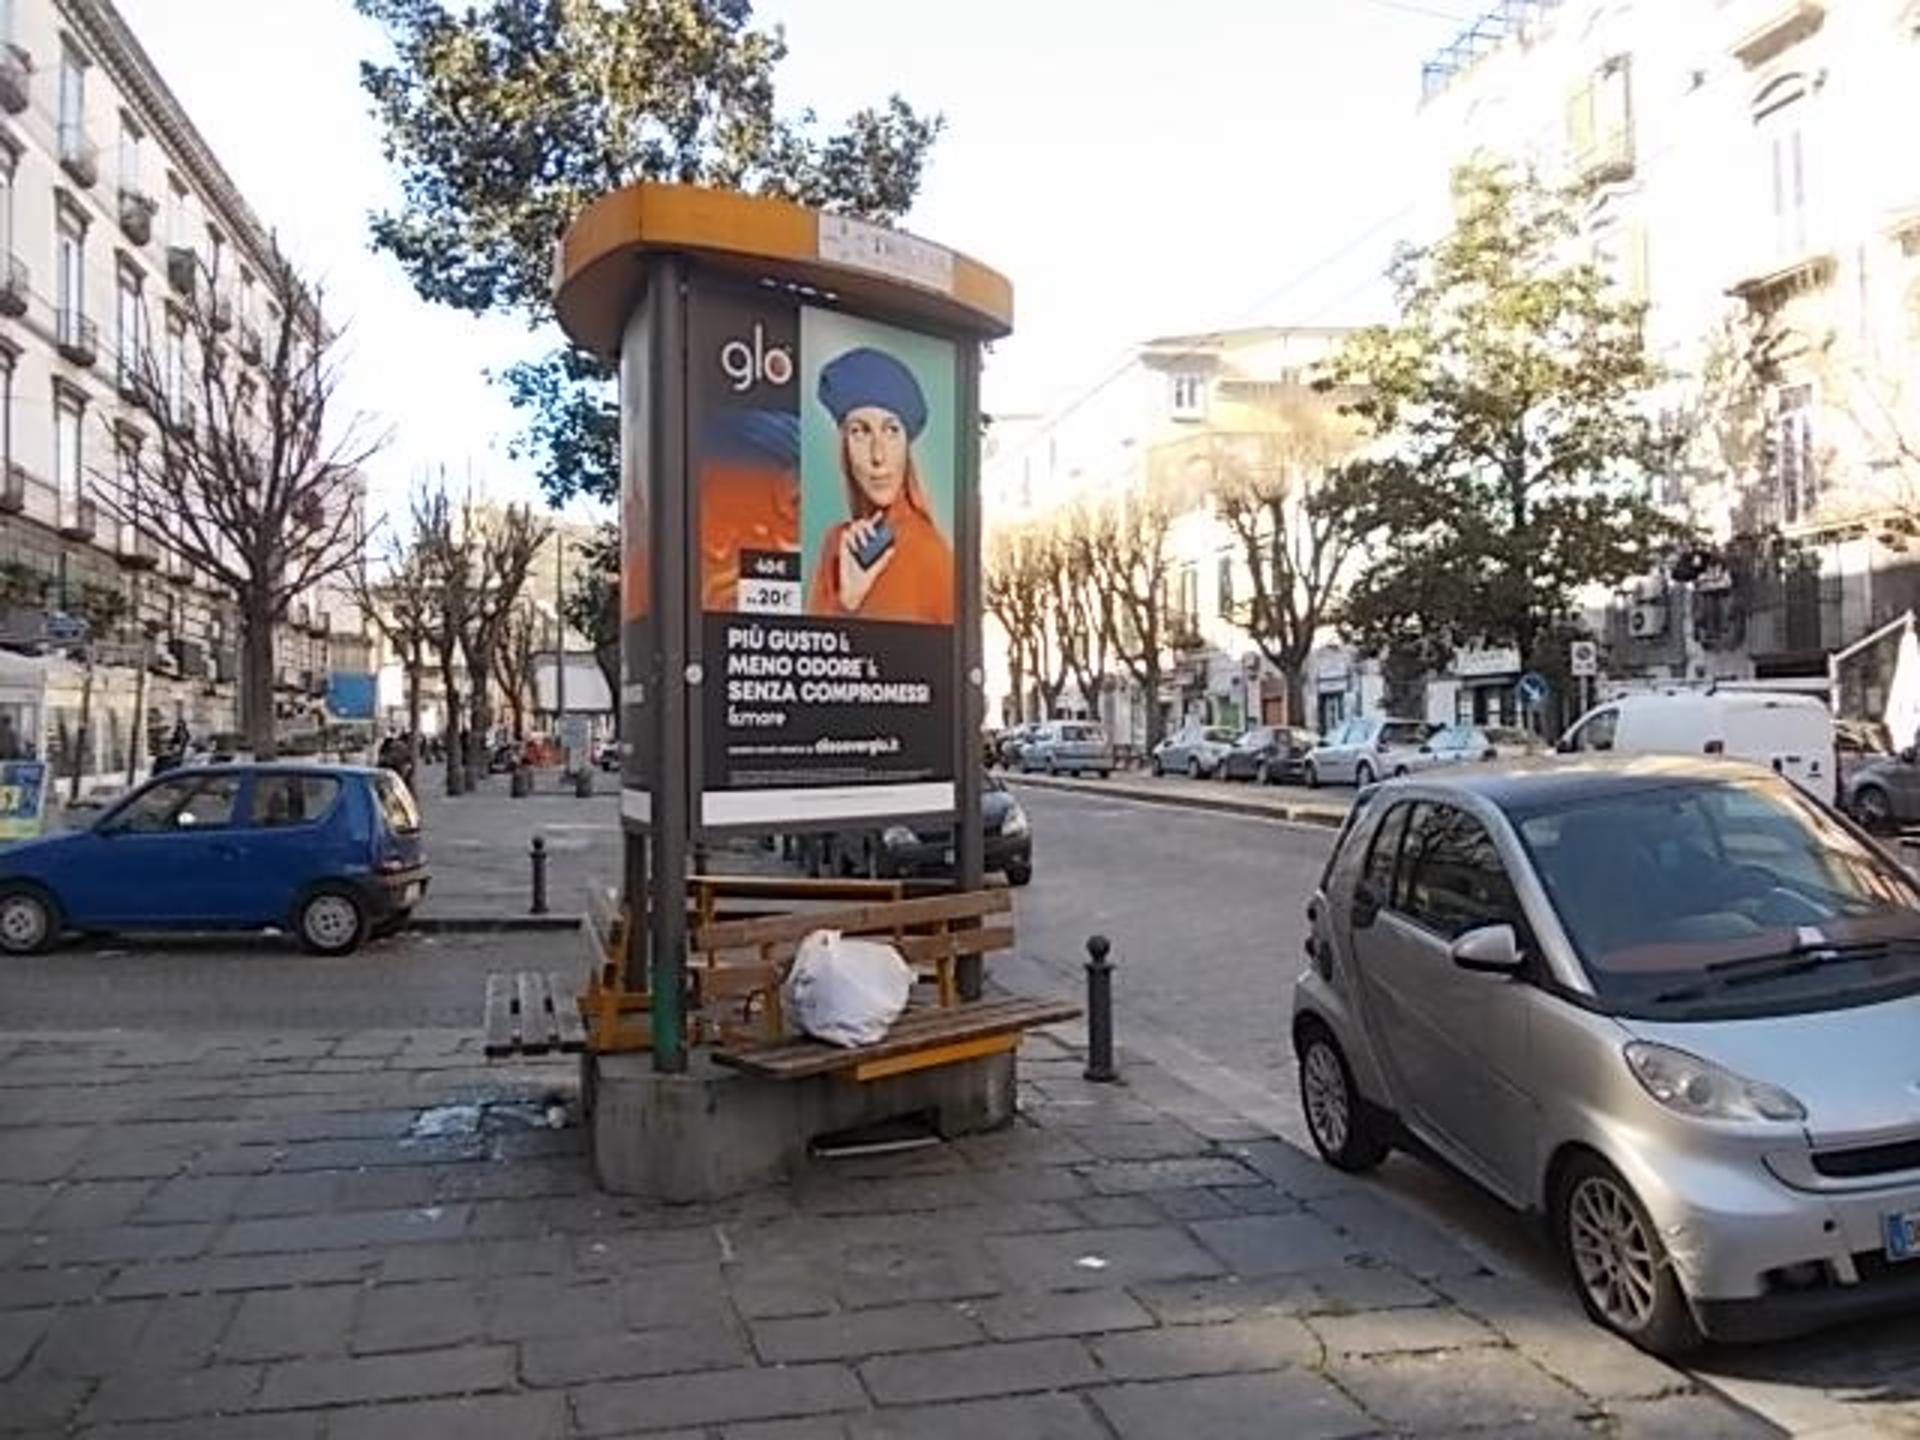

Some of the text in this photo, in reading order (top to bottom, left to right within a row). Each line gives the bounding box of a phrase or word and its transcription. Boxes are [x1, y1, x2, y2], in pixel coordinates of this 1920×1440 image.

[722, 322, 792, 391] glo
[728, 625, 763, 650] PIÙ
[768, 630, 838, 652] GUSTO
[728, 655, 793, 676] MENO
[796, 657, 862, 678] ODORE
[728, 680, 798, 701] SENZA
